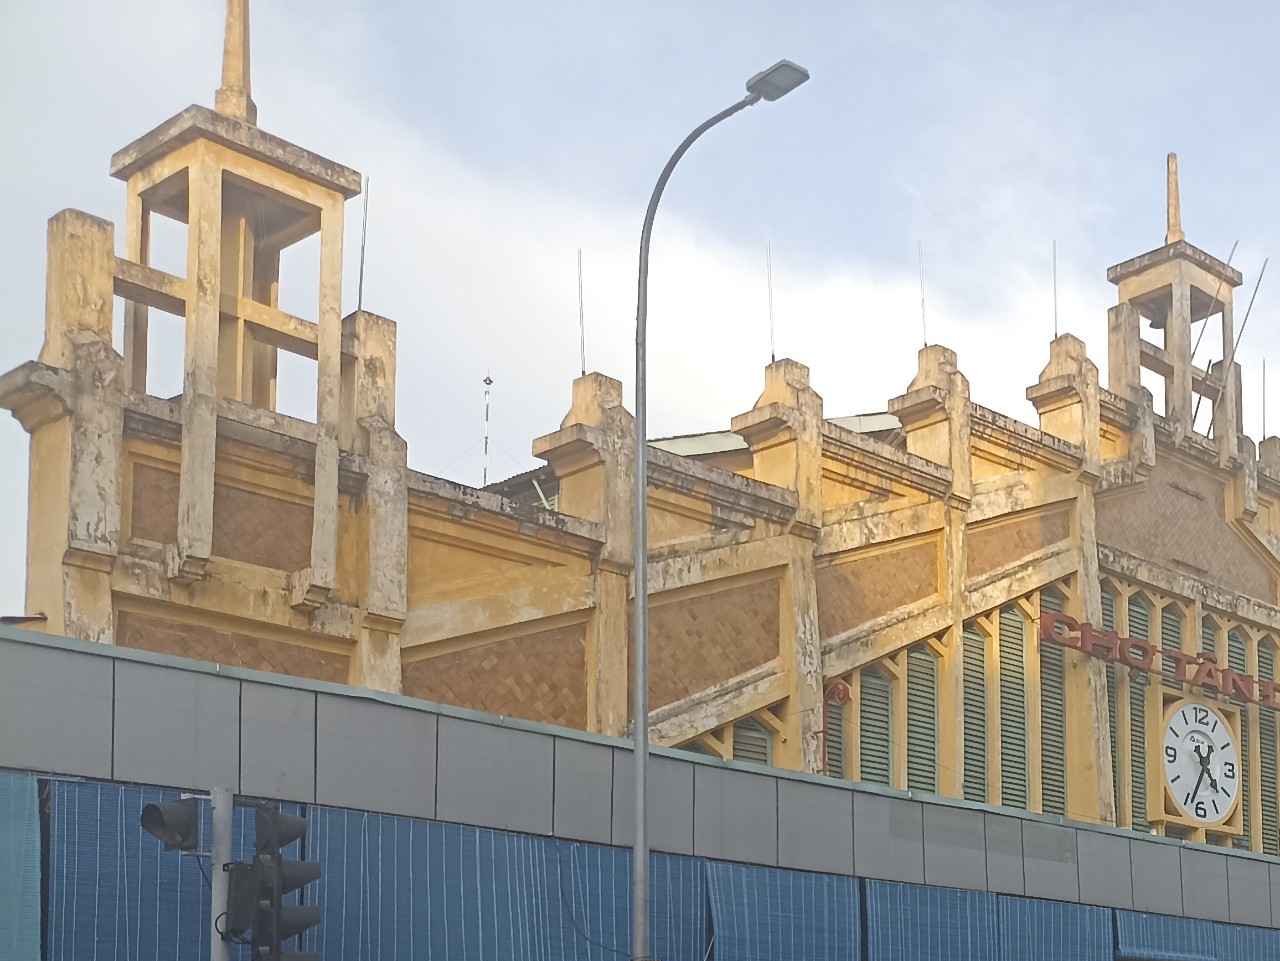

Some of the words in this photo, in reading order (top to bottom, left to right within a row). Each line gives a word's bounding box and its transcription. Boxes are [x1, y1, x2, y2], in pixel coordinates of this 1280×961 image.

[1041, 613, 1157, 680] CHỢ
[1163, 650, 1254, 699] TÂN
[1193, 707, 1209, 726] 12
[1165, 746, 1177, 763] 9
[1223, 762, 1235, 779] 3
[1195, 802, 1207, 818] 6
